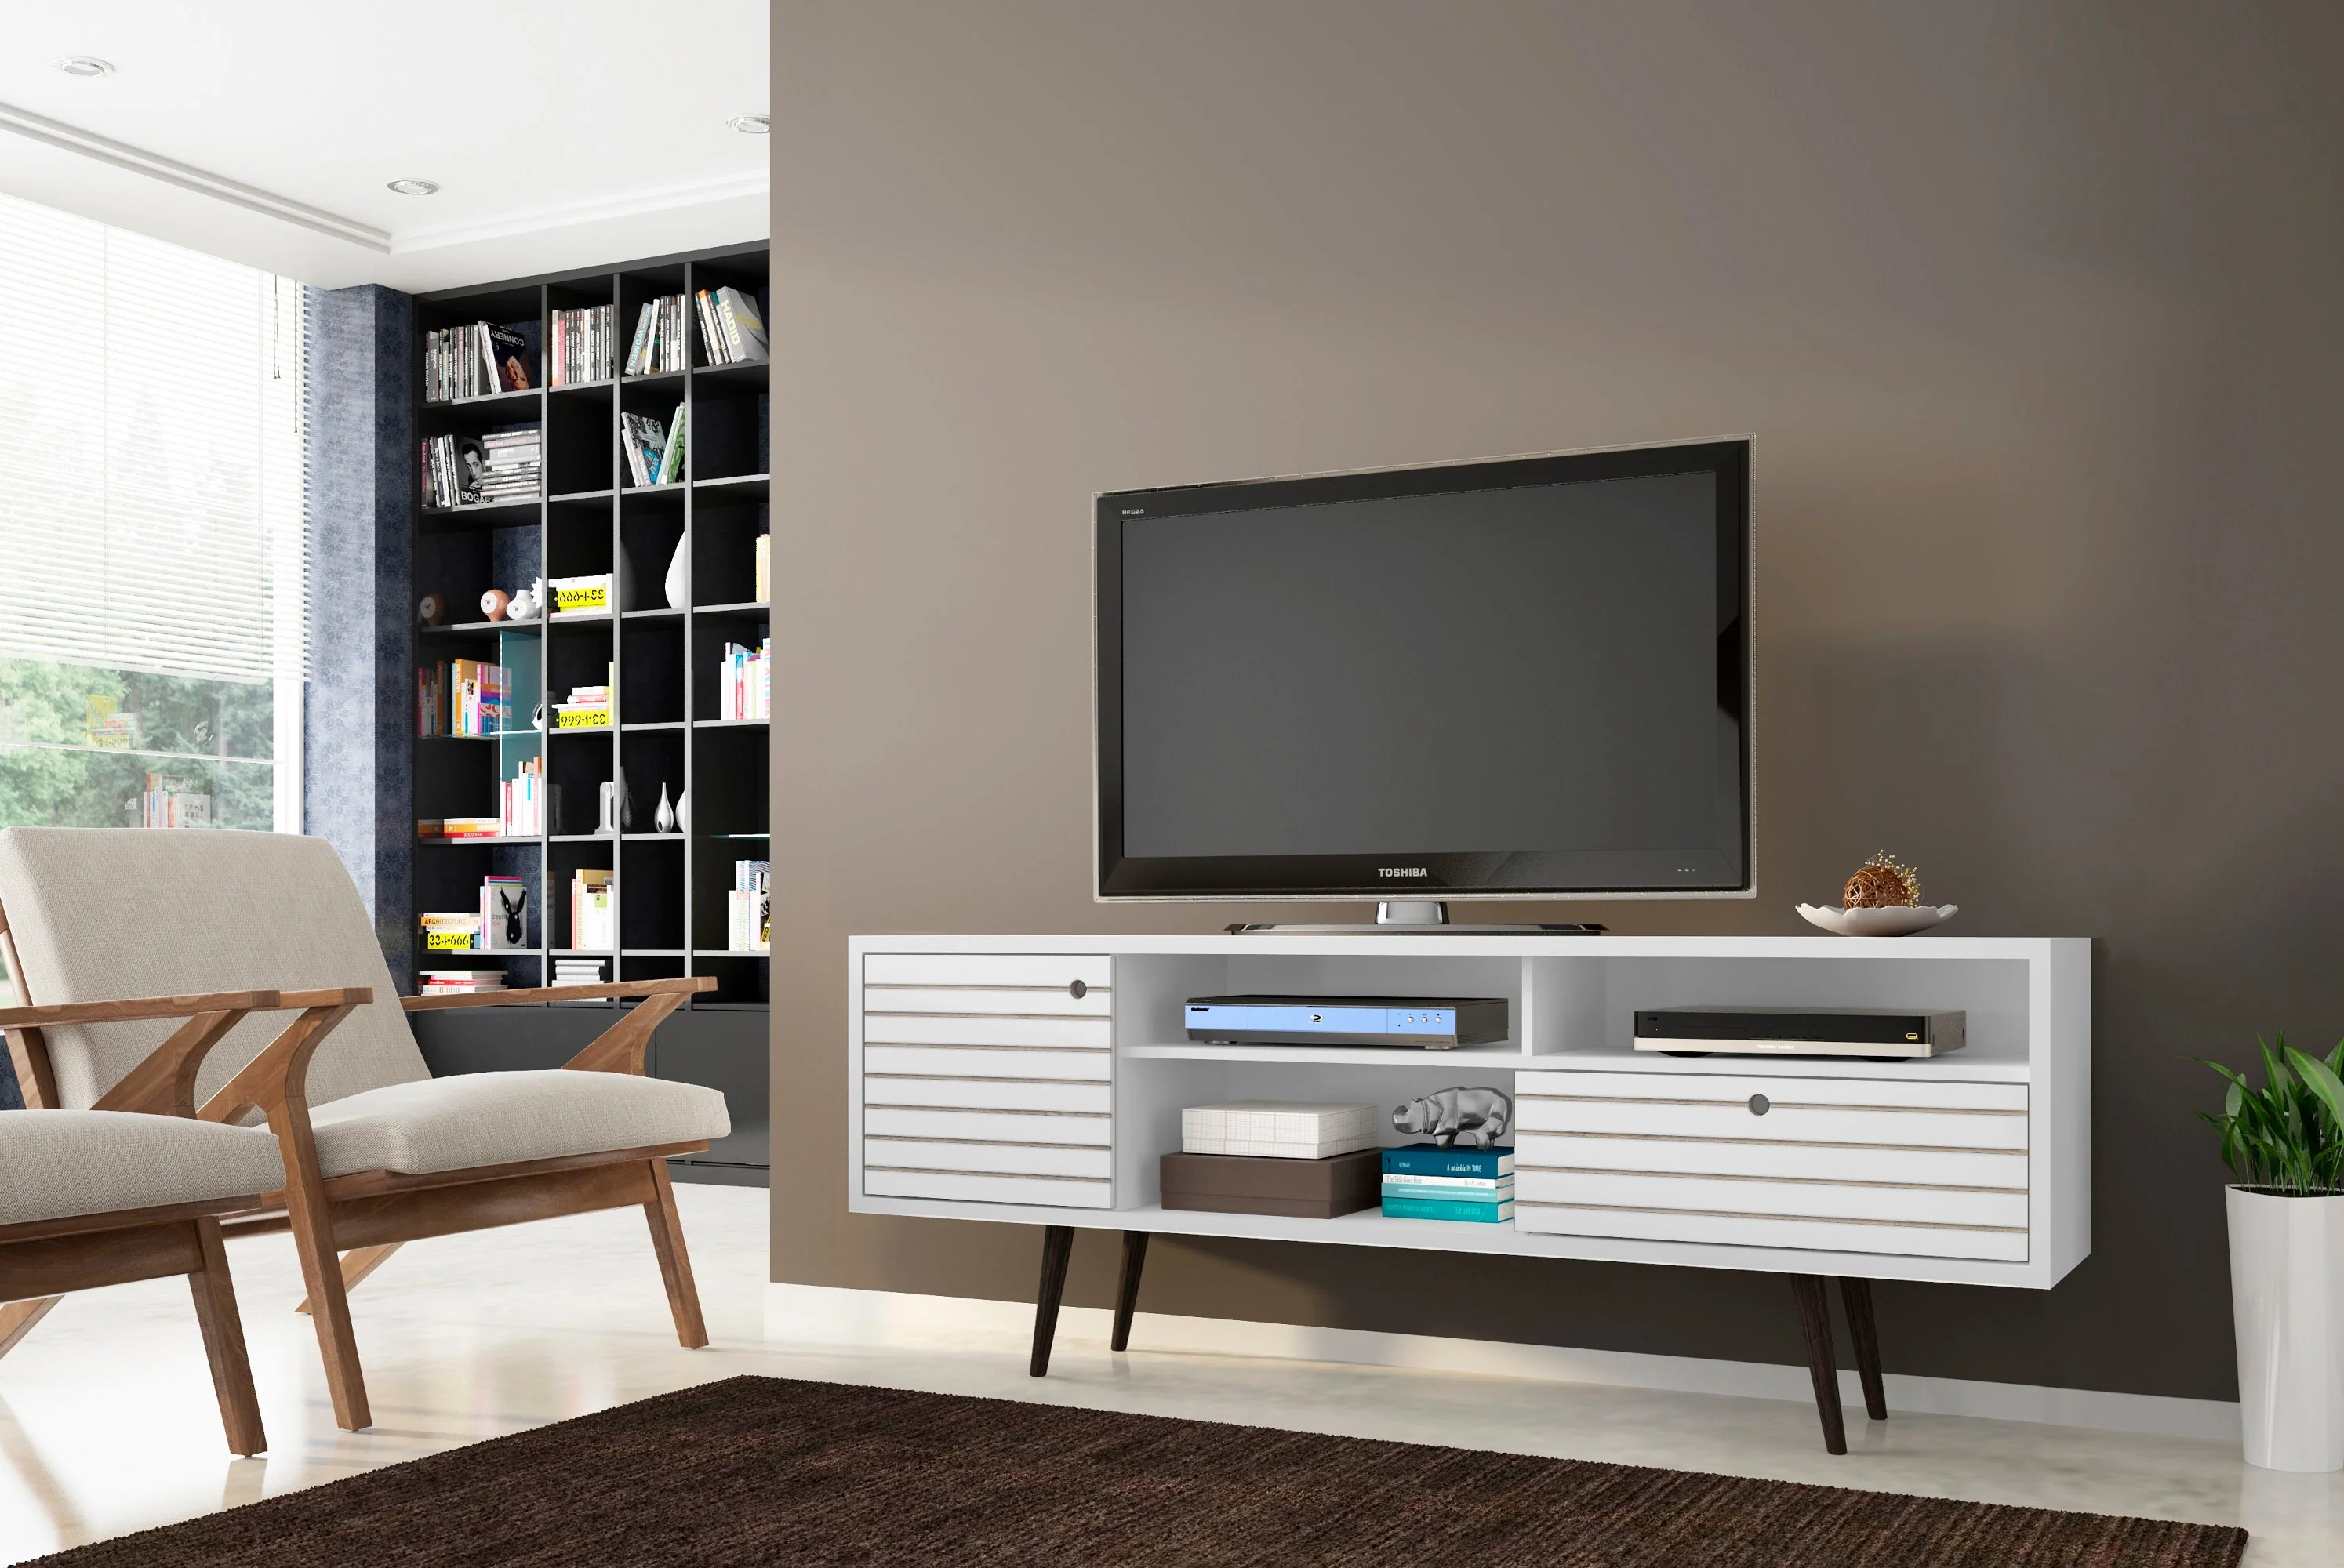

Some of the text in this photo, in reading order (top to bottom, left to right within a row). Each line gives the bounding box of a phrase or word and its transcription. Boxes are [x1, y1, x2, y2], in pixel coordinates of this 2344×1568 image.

[641, 307, 651, 329] MODERN
[721, 299, 740, 345] HADID
[491, 329, 525, 346] CONNERY
[629, 329, 645, 367] WOMEN
[461, 491, 493, 503] BOGAR
[1378, 867, 1428, 877] TOSHIBA
[429, 935, 469, 946] 334-666
